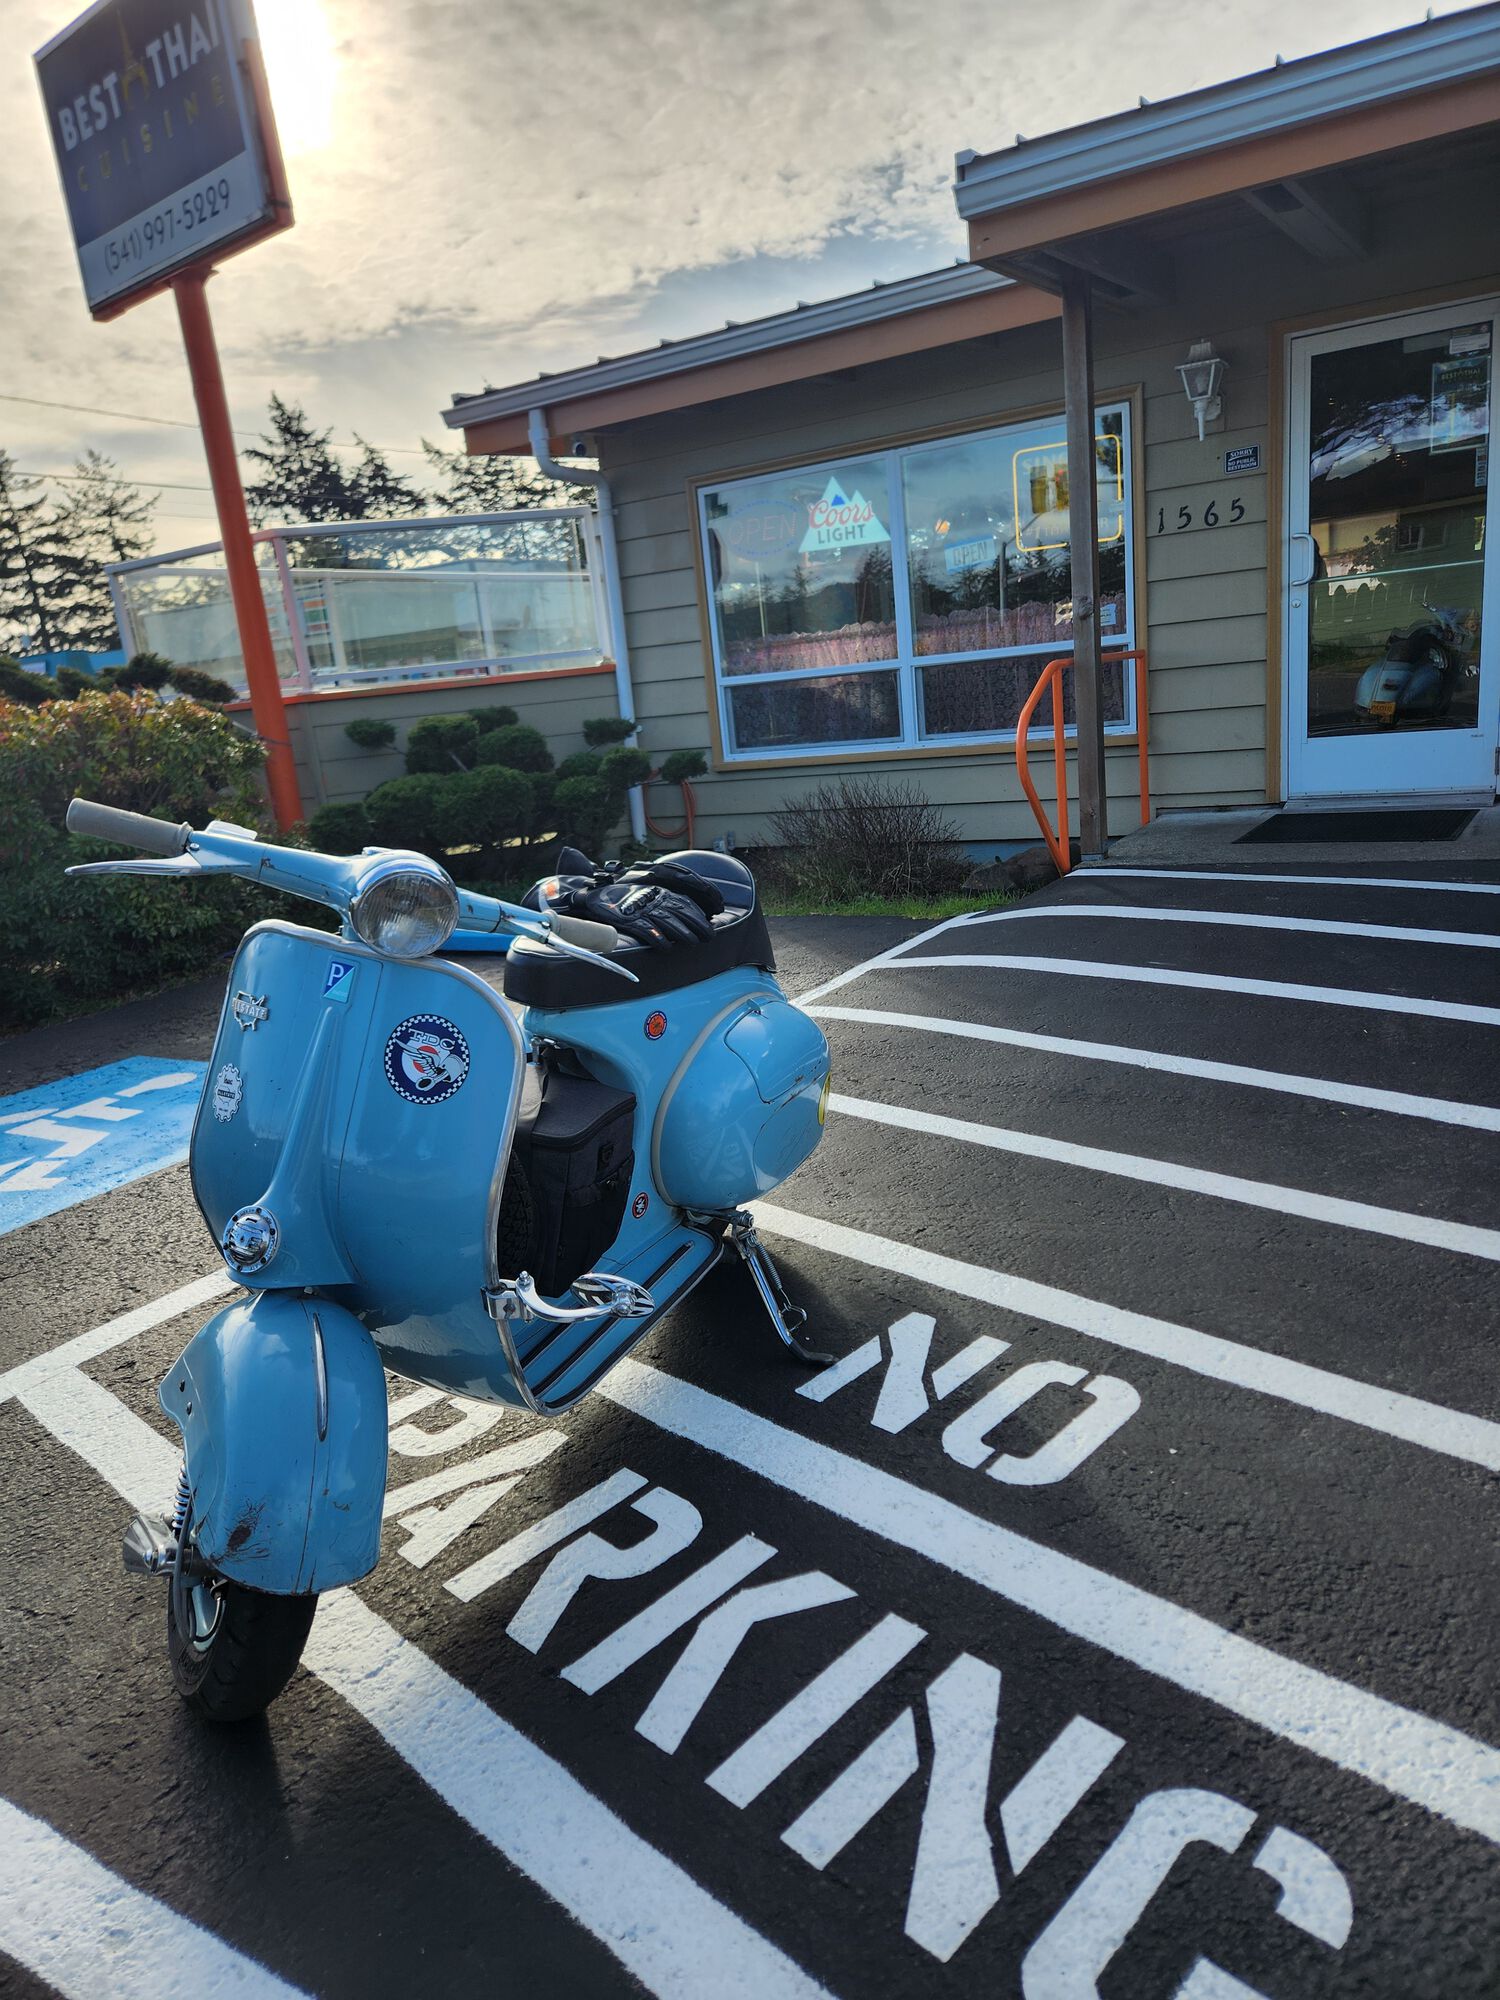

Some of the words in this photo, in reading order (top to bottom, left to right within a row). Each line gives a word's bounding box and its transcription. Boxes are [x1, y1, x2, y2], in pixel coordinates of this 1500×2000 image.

[58, 72, 121, 152] BEST
[145, 0, 221, 89] THAI
[77, 75, 225, 192] CUISINE
[1230, 448, 1254, 458] SORRY
[728, 512, 797, 545] OPEN
[808, 499, 875, 529] Coors
[1158, 498, 1245, 533] 1565
[817, 524, 867, 545] LIGHT
[953, 541, 988, 566] OPEN
[327, 963, 344, 986] P
[408, 1028, 456, 1050] TDC
[795, 1312, 1142, 1487] NO
[377, 1386, 1353, 2000] PARKING
